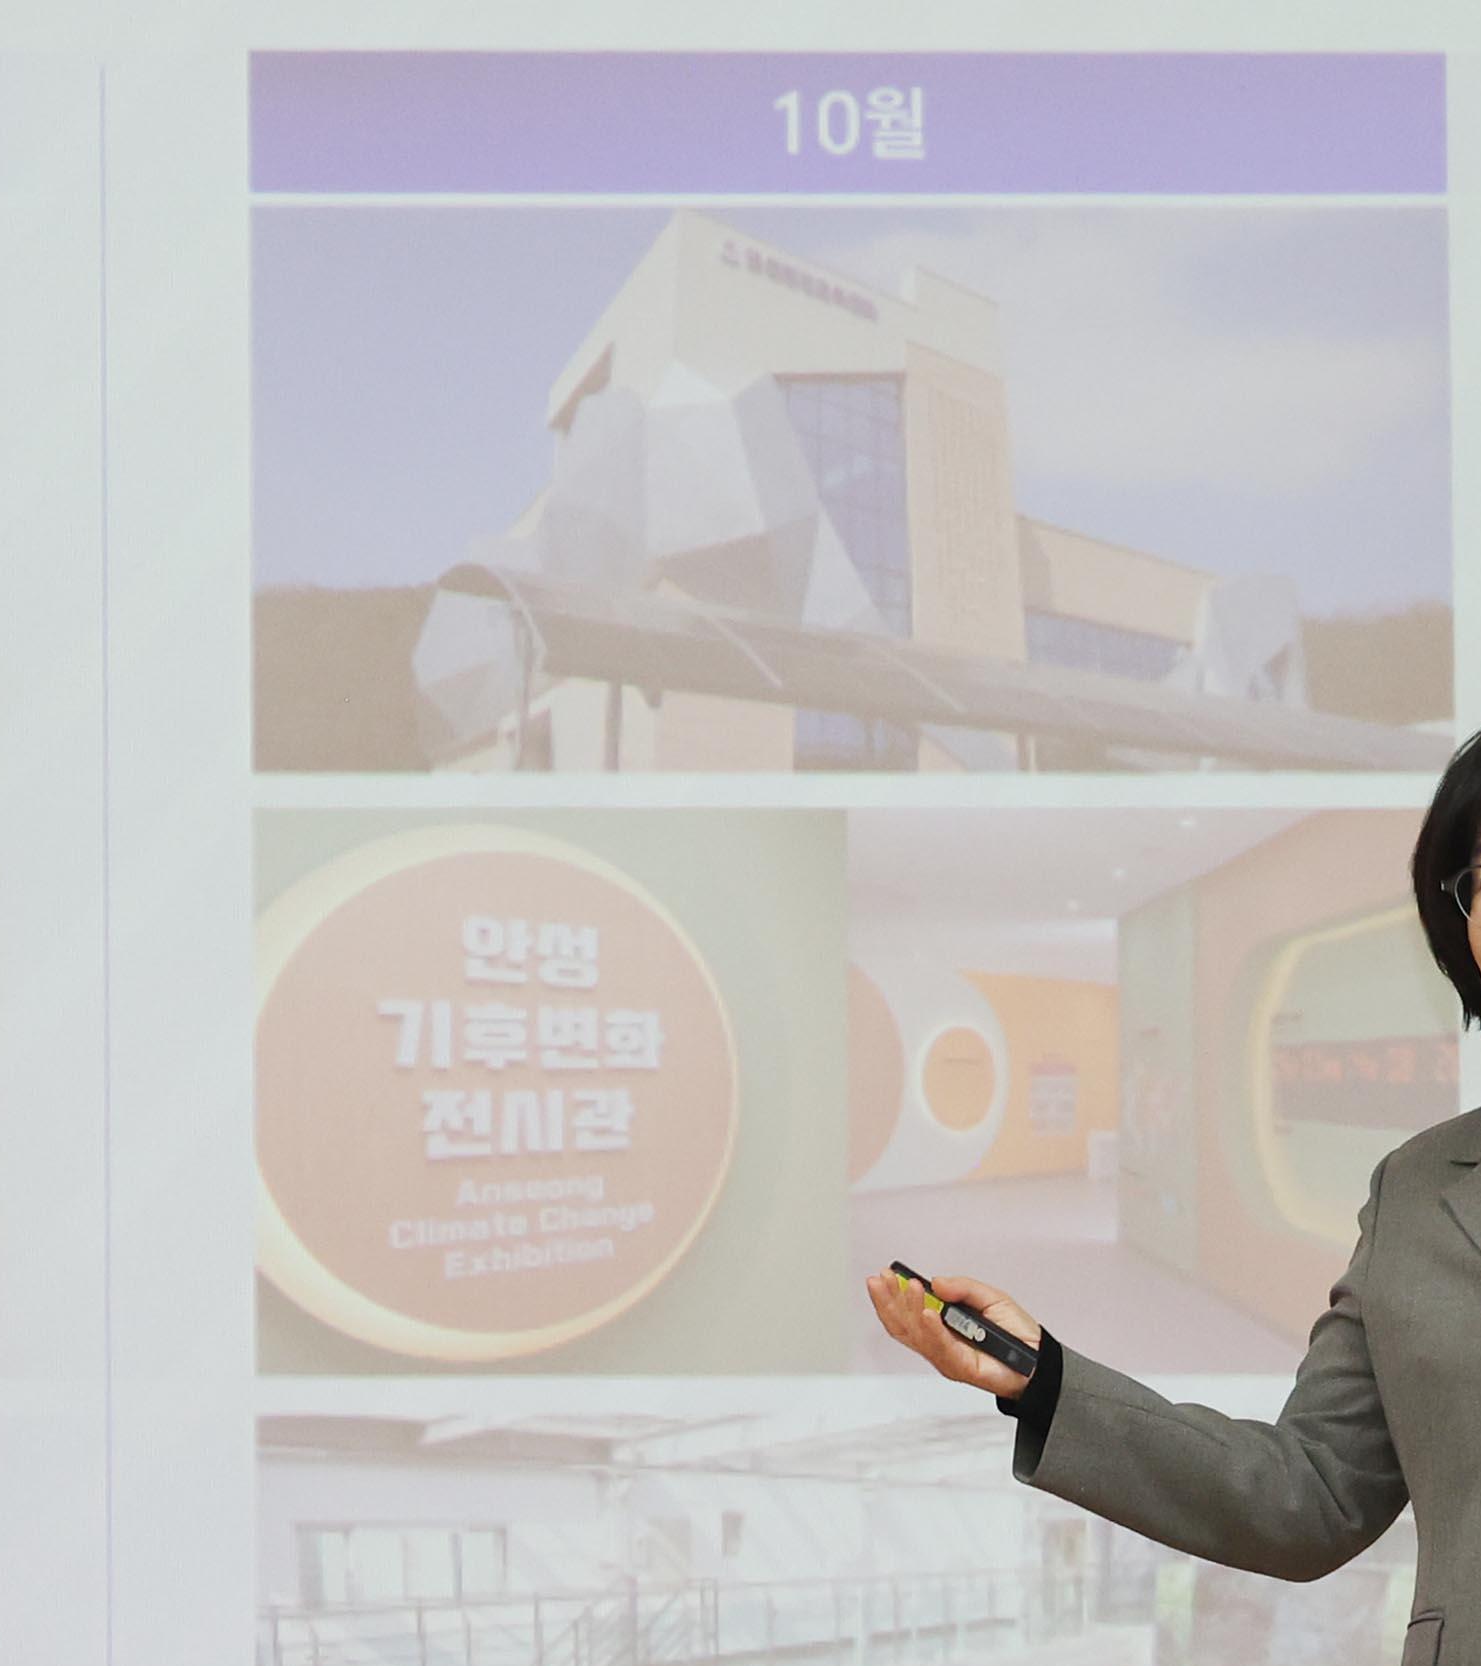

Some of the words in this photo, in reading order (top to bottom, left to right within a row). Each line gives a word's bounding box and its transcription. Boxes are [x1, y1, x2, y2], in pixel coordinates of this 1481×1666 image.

[773, 85, 926, 160] 10월
[379, 1001, 663, 1069] 기후변화
[423, 1088, 632, 1158] 전시관
[391, 1212, 528, 1248] Climate
[539, 1203, 655, 1231] Change
[445, 1238, 615, 1279] Exhibition
